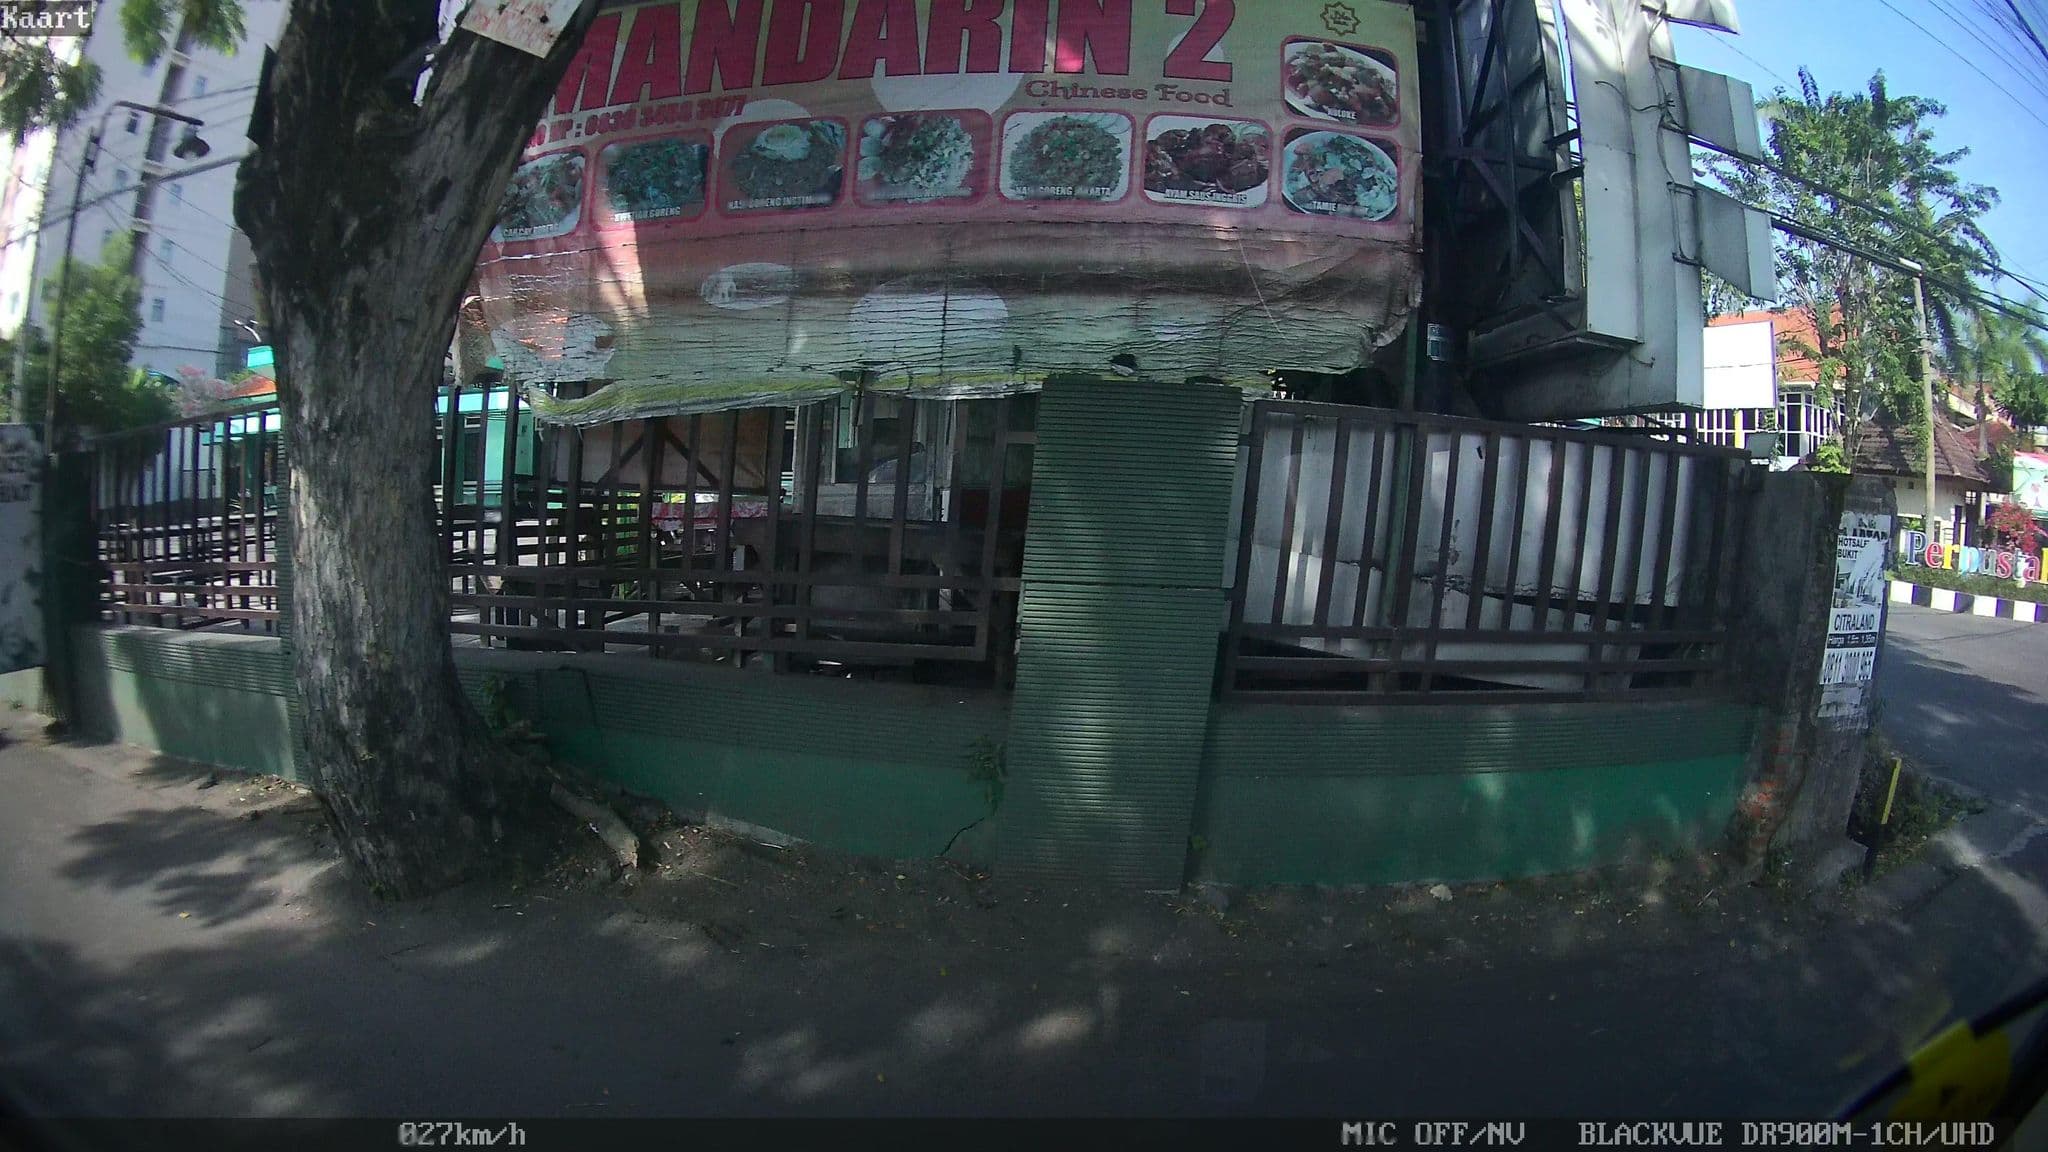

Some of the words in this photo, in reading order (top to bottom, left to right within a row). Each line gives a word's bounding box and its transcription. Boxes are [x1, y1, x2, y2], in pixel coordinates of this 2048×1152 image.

[551, 0, 1132, 116] MANDARIN
[1163, 0, 1234, 82] 2
[1024, 80, 1148, 100] Chinese
[1154, 83, 1233, 107] Food
[1837, 548, 1859, 560] BUKIT
[1833, 614, 1876, 632] CITRALAND
